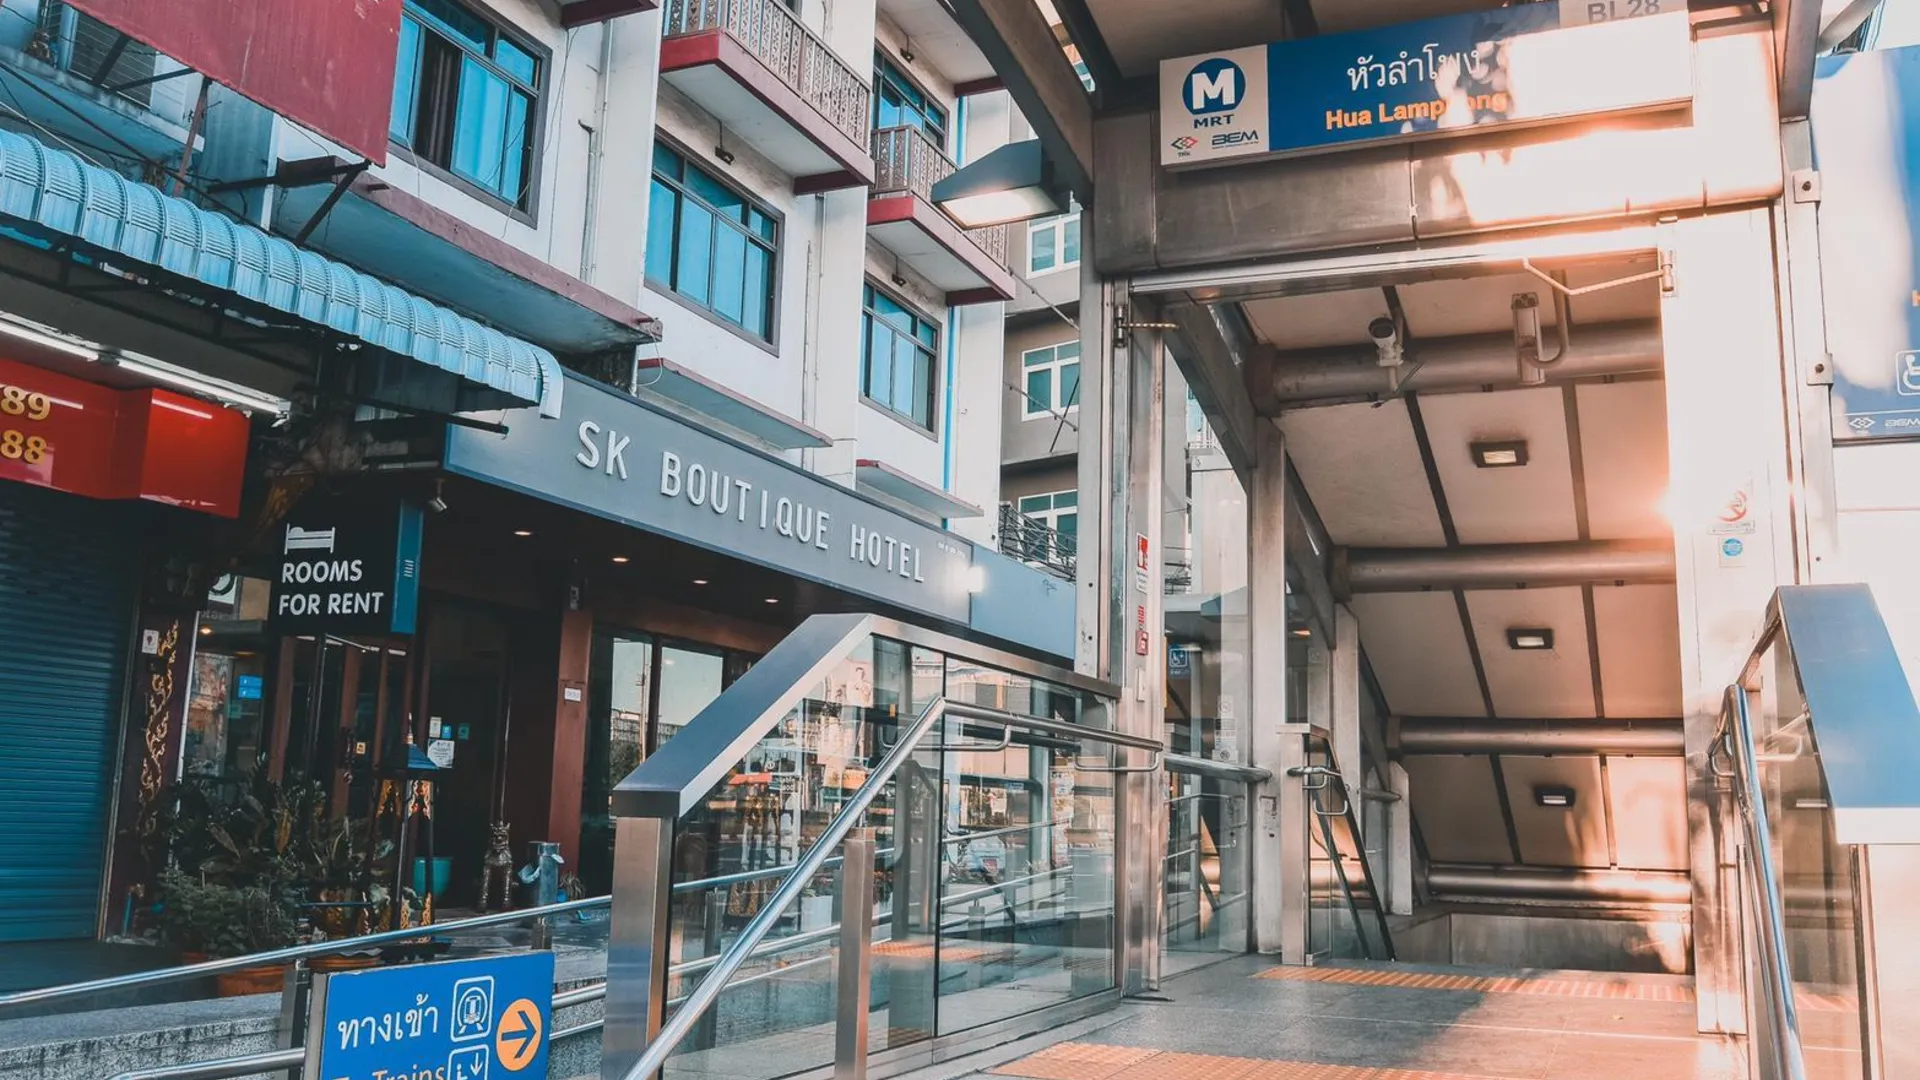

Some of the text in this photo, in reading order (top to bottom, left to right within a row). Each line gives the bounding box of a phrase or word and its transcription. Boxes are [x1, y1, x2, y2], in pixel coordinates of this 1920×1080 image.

[1347, 43, 1482, 91] หัวลำโพง
[1192, 67, 1235, 110] M
[1194, 114, 1235, 129] MRT
[1326, 91, 1508, 130] Hua Lampong
[1212, 130, 1259, 146] BEM
[575, 420, 925, 584] SK BOUTIQUE HOTEL
[281, 559, 363, 584] ROOMS
[278, 591, 385, 616] FOR RENT
[337, 993, 439, 1051] ทางเข้า
